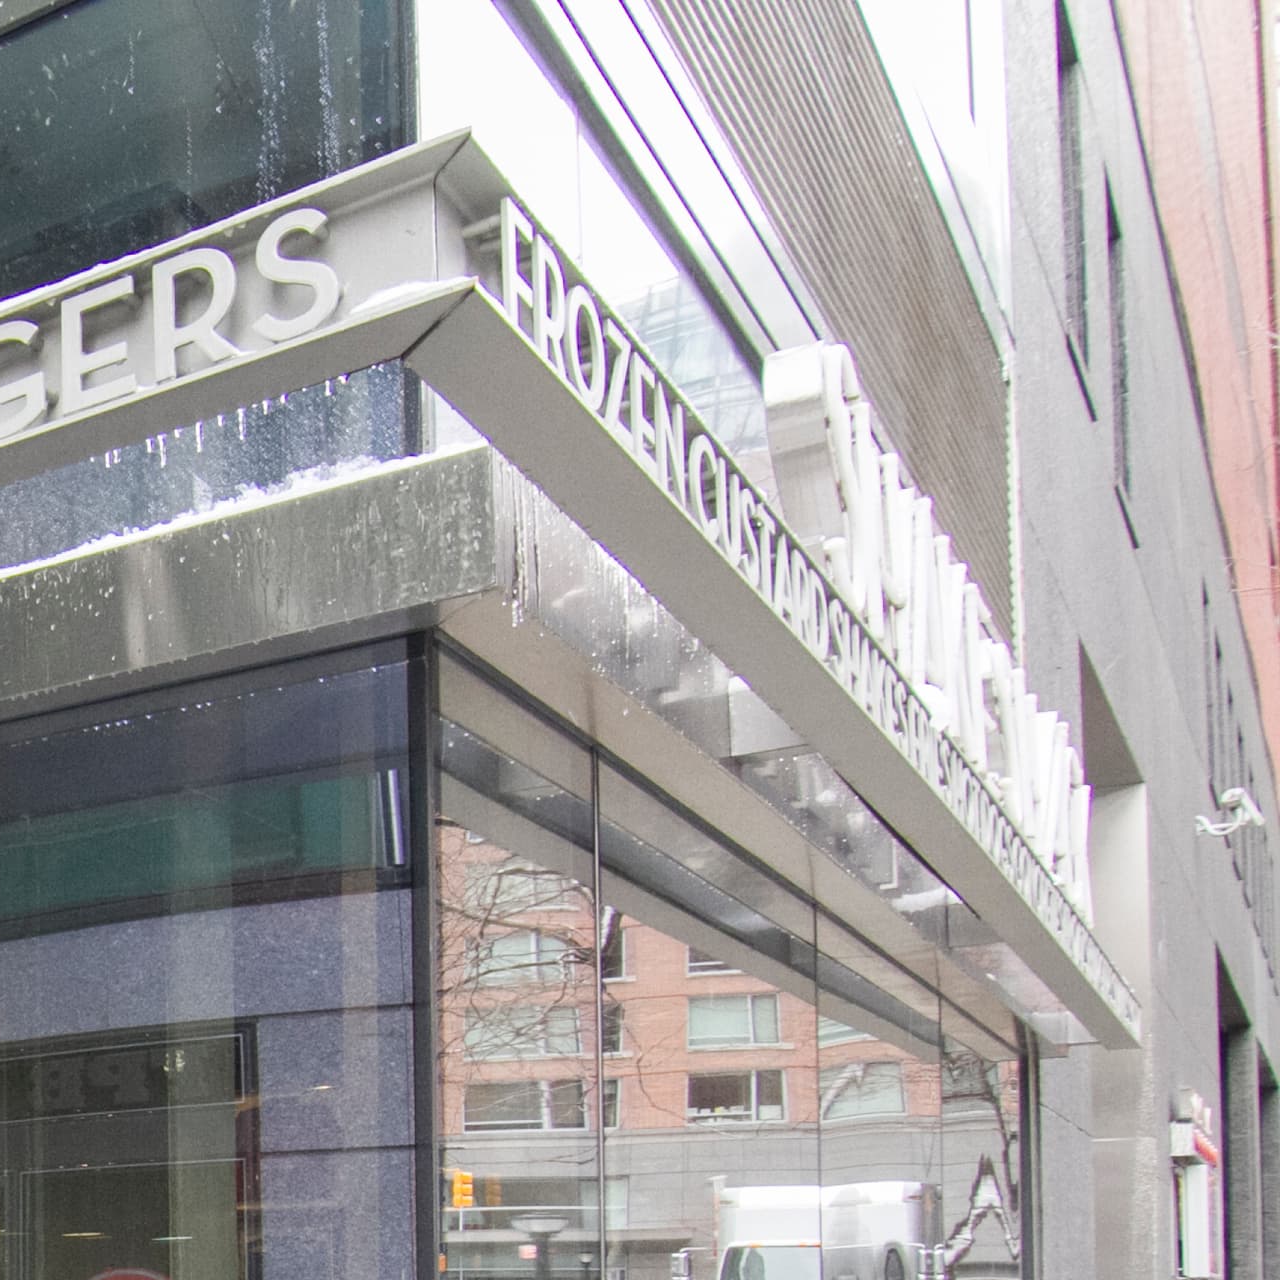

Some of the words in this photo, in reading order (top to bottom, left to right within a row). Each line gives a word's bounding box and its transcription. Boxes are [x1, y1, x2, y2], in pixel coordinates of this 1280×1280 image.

[500, 196, 687, 507] FROZEN
[688, 433, 831, 662] CUSTARD
[828, 598, 909, 757] SHAKES
